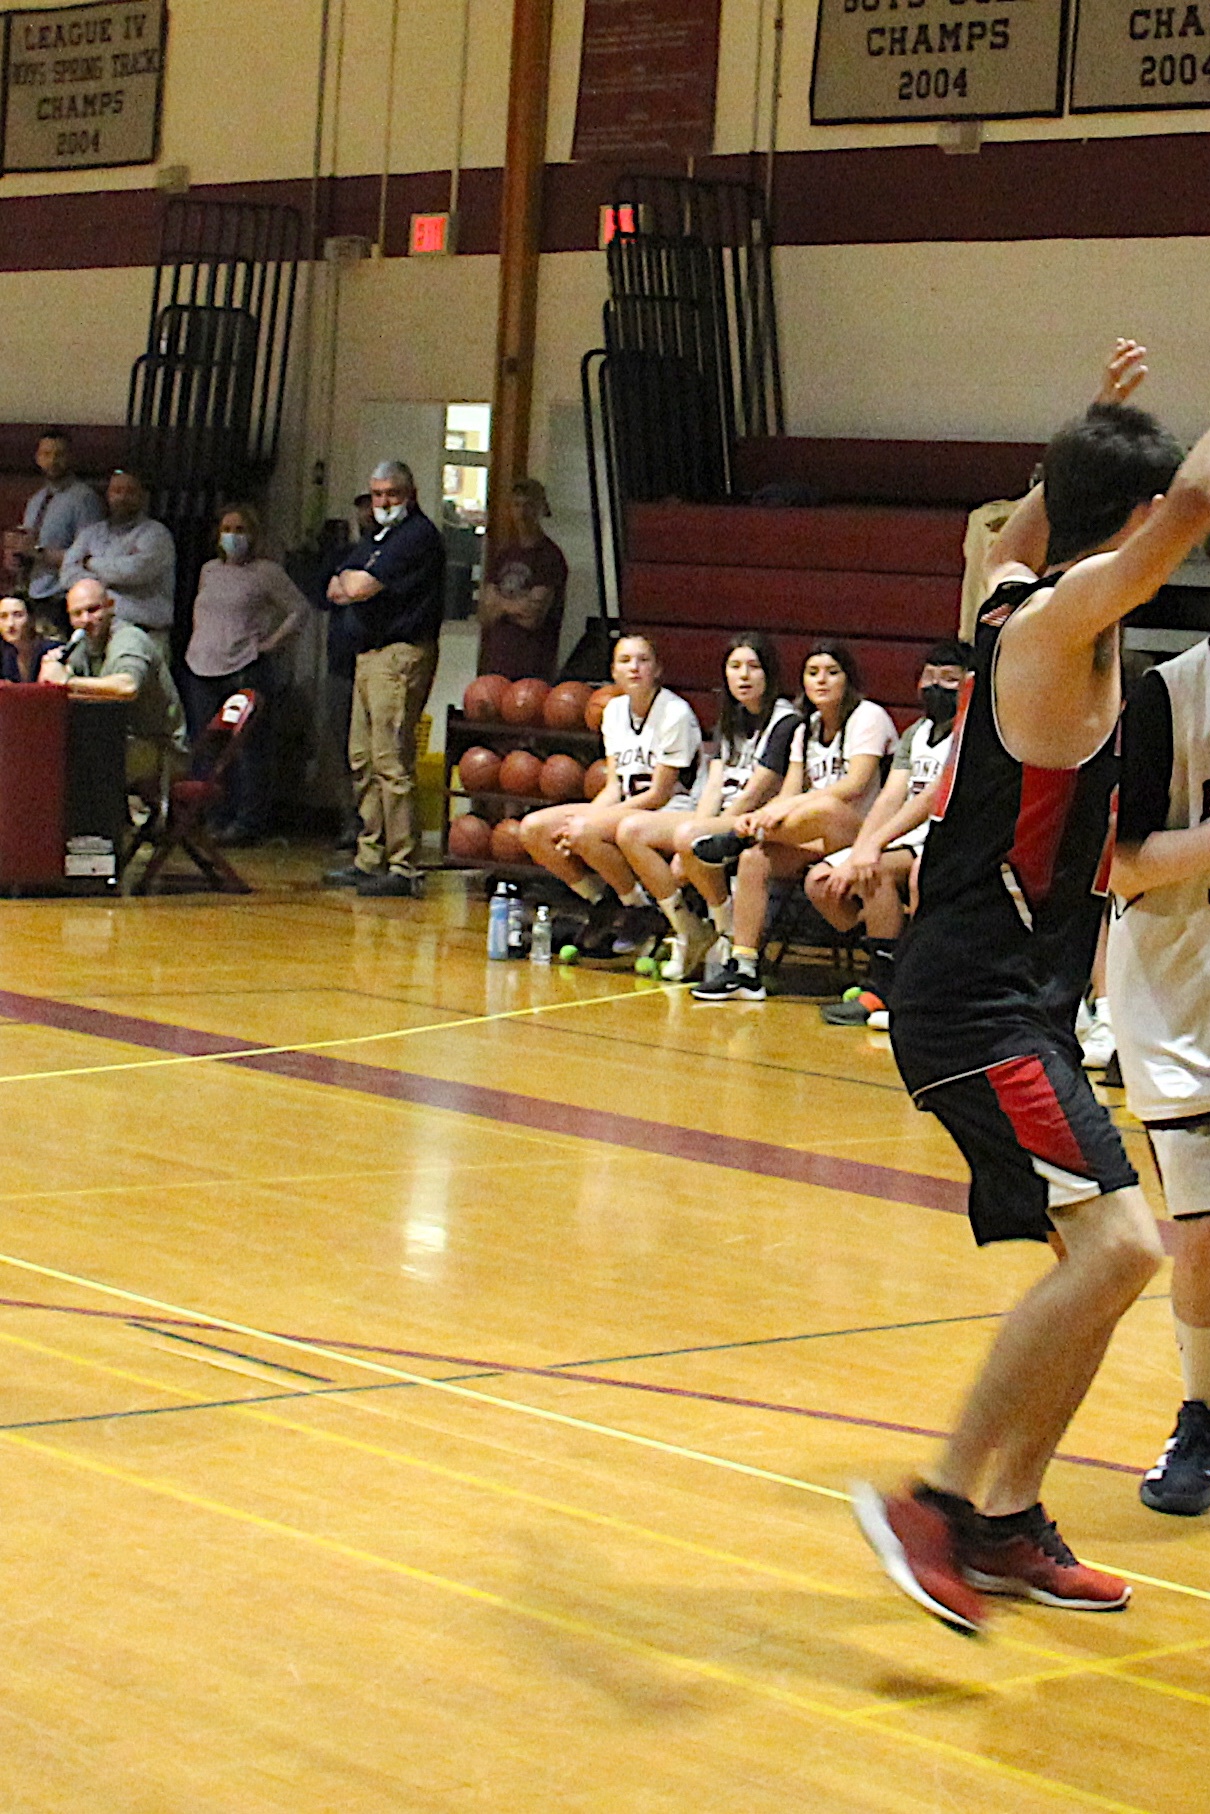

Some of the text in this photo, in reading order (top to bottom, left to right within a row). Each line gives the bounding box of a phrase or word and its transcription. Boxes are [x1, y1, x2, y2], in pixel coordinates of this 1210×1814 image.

[25, 18, 113, 50] LEAGUE
[866, 18, 1010, 57] CHAMPS
[898, 67, 969, 100] 2004
[36, 90, 125, 120] CHAMPS
